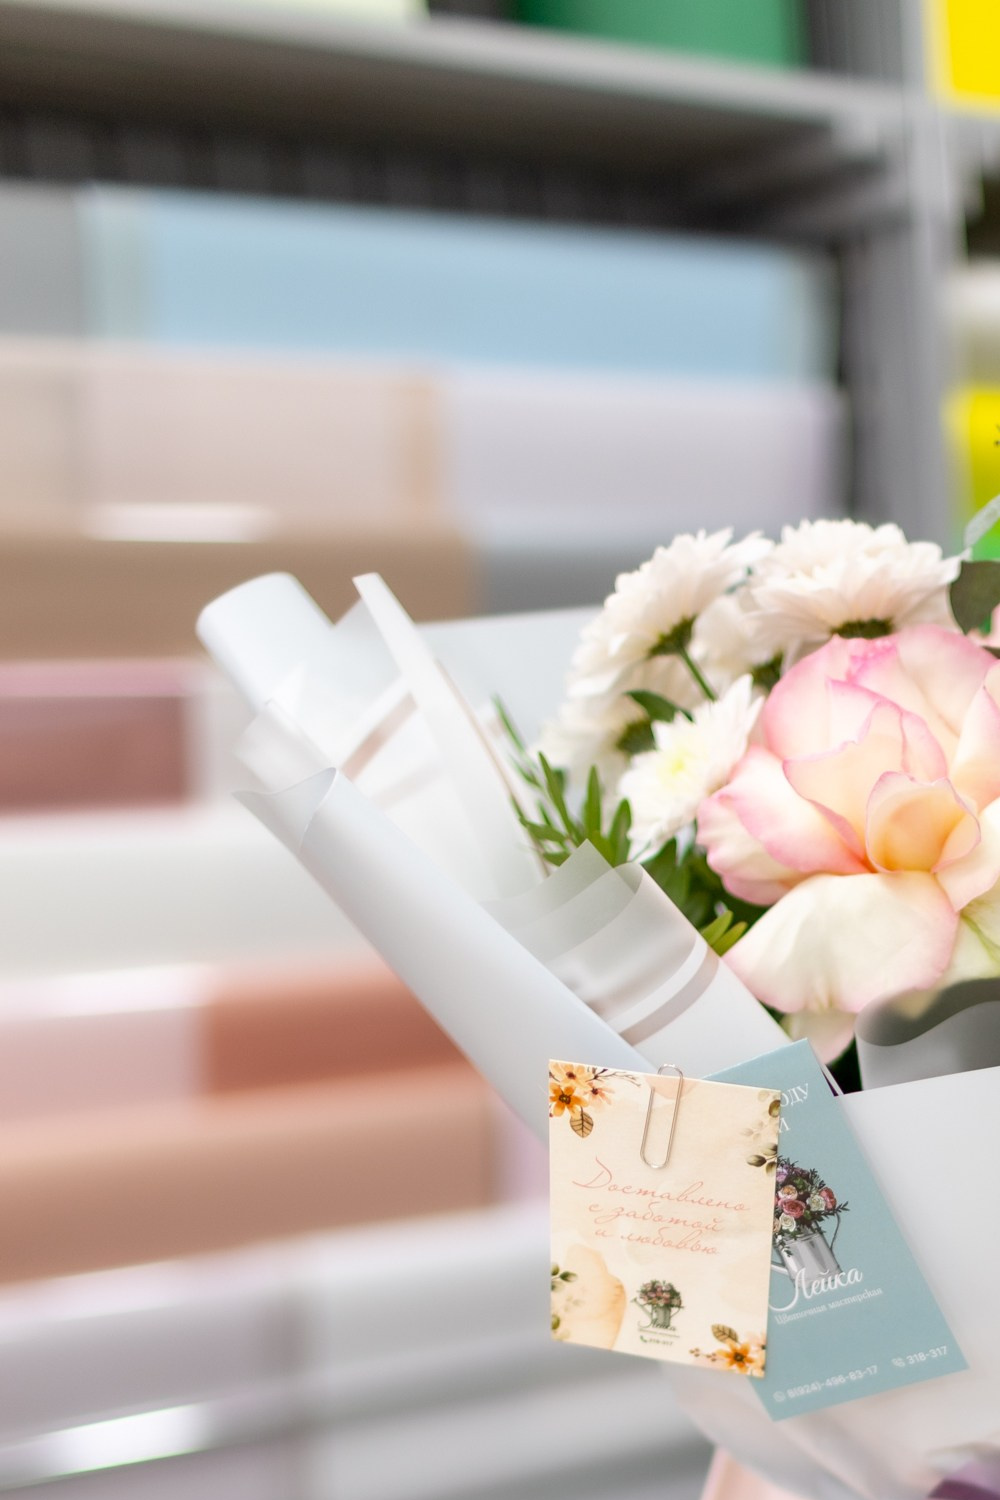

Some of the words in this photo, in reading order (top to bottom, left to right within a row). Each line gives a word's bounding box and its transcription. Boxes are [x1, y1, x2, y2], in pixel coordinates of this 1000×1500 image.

[780, 1083, 810, 1107] ОДУ
[572, 1156, 750, 1212] Доставлено
[589, 1203, 602, 1213] с
[594, 1201, 724, 1233] заботой
[595, 1229, 612, 1239] и
[621, 1227, 719, 1255] любовью
[768, 1266, 864, 1312] Лейка
[774, 1302, 828, 1326] Цветочная
[827, 1286, 884, 1312] мастерская
[906, 1344, 949, 1366] 318-317
